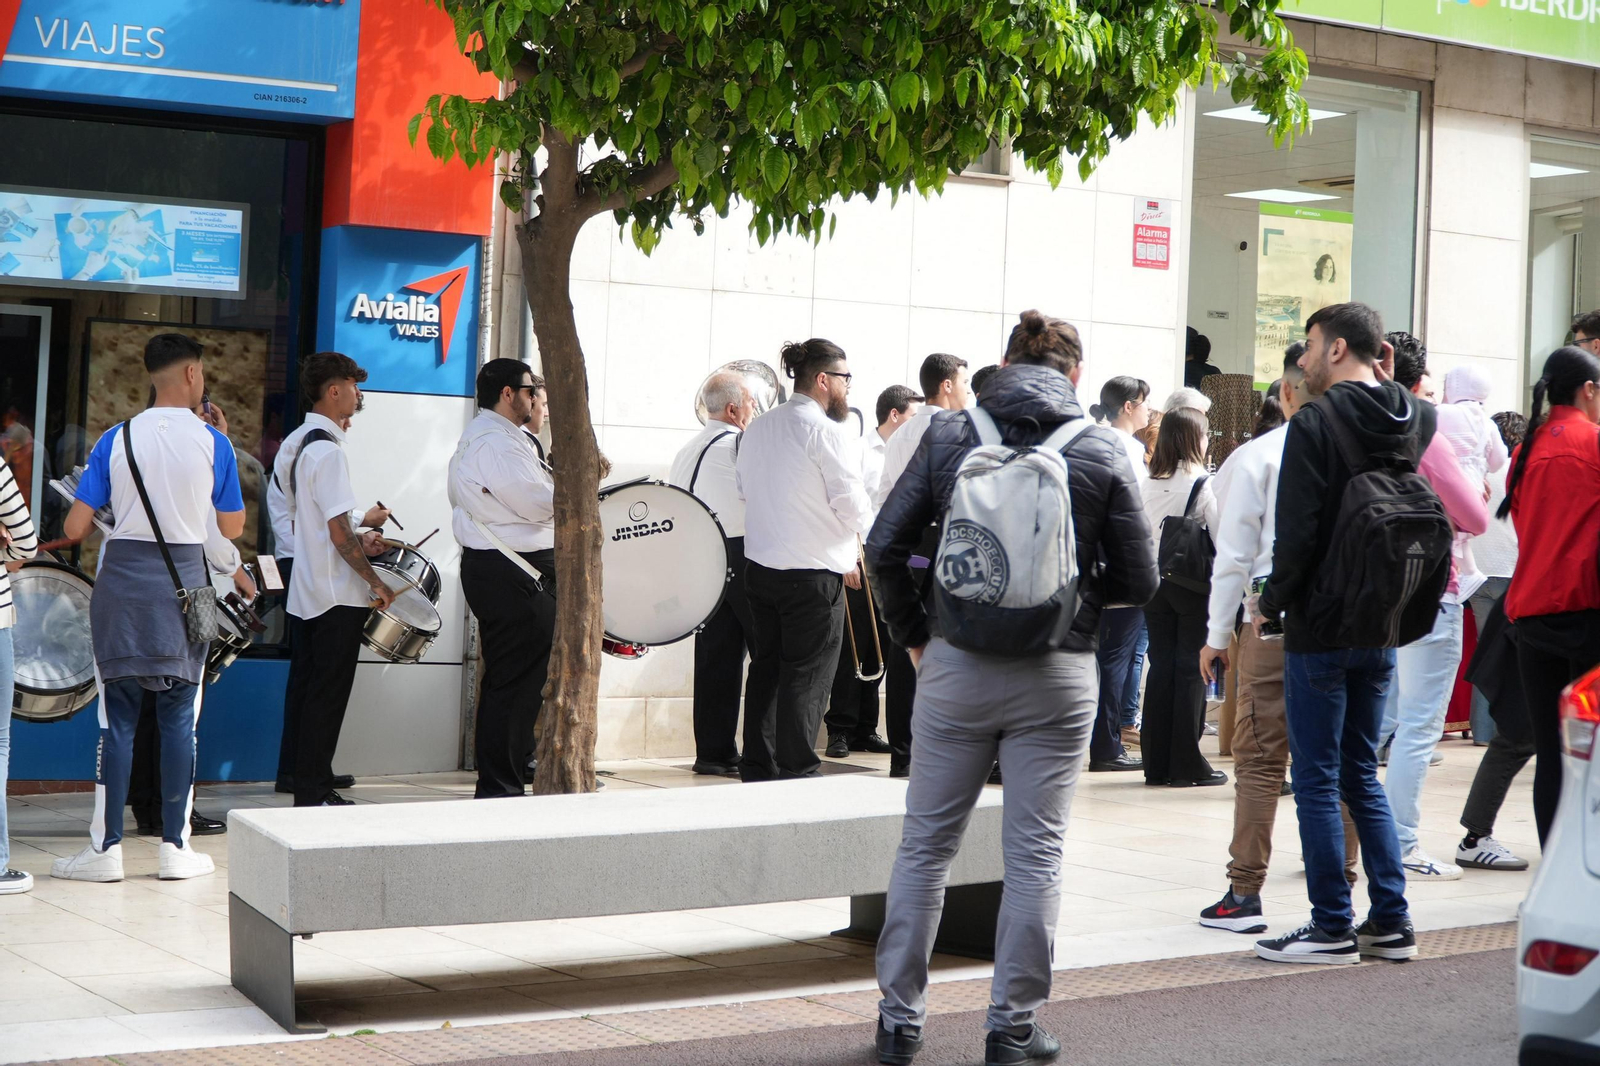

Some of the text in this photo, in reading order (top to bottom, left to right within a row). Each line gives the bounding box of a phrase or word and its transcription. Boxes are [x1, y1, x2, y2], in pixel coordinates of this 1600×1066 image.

[1500, 0, 1600, 23] ERDR
[34, 15, 166, 59] VIAJES
[253, 93, 307, 104] CIAN 216306-2
[1137, 227, 1168, 238] Alarma
[351, 293, 440, 323] Avialia
[396, 323, 440, 338] VIAJES
[612, 519, 674, 542] JINBAO
